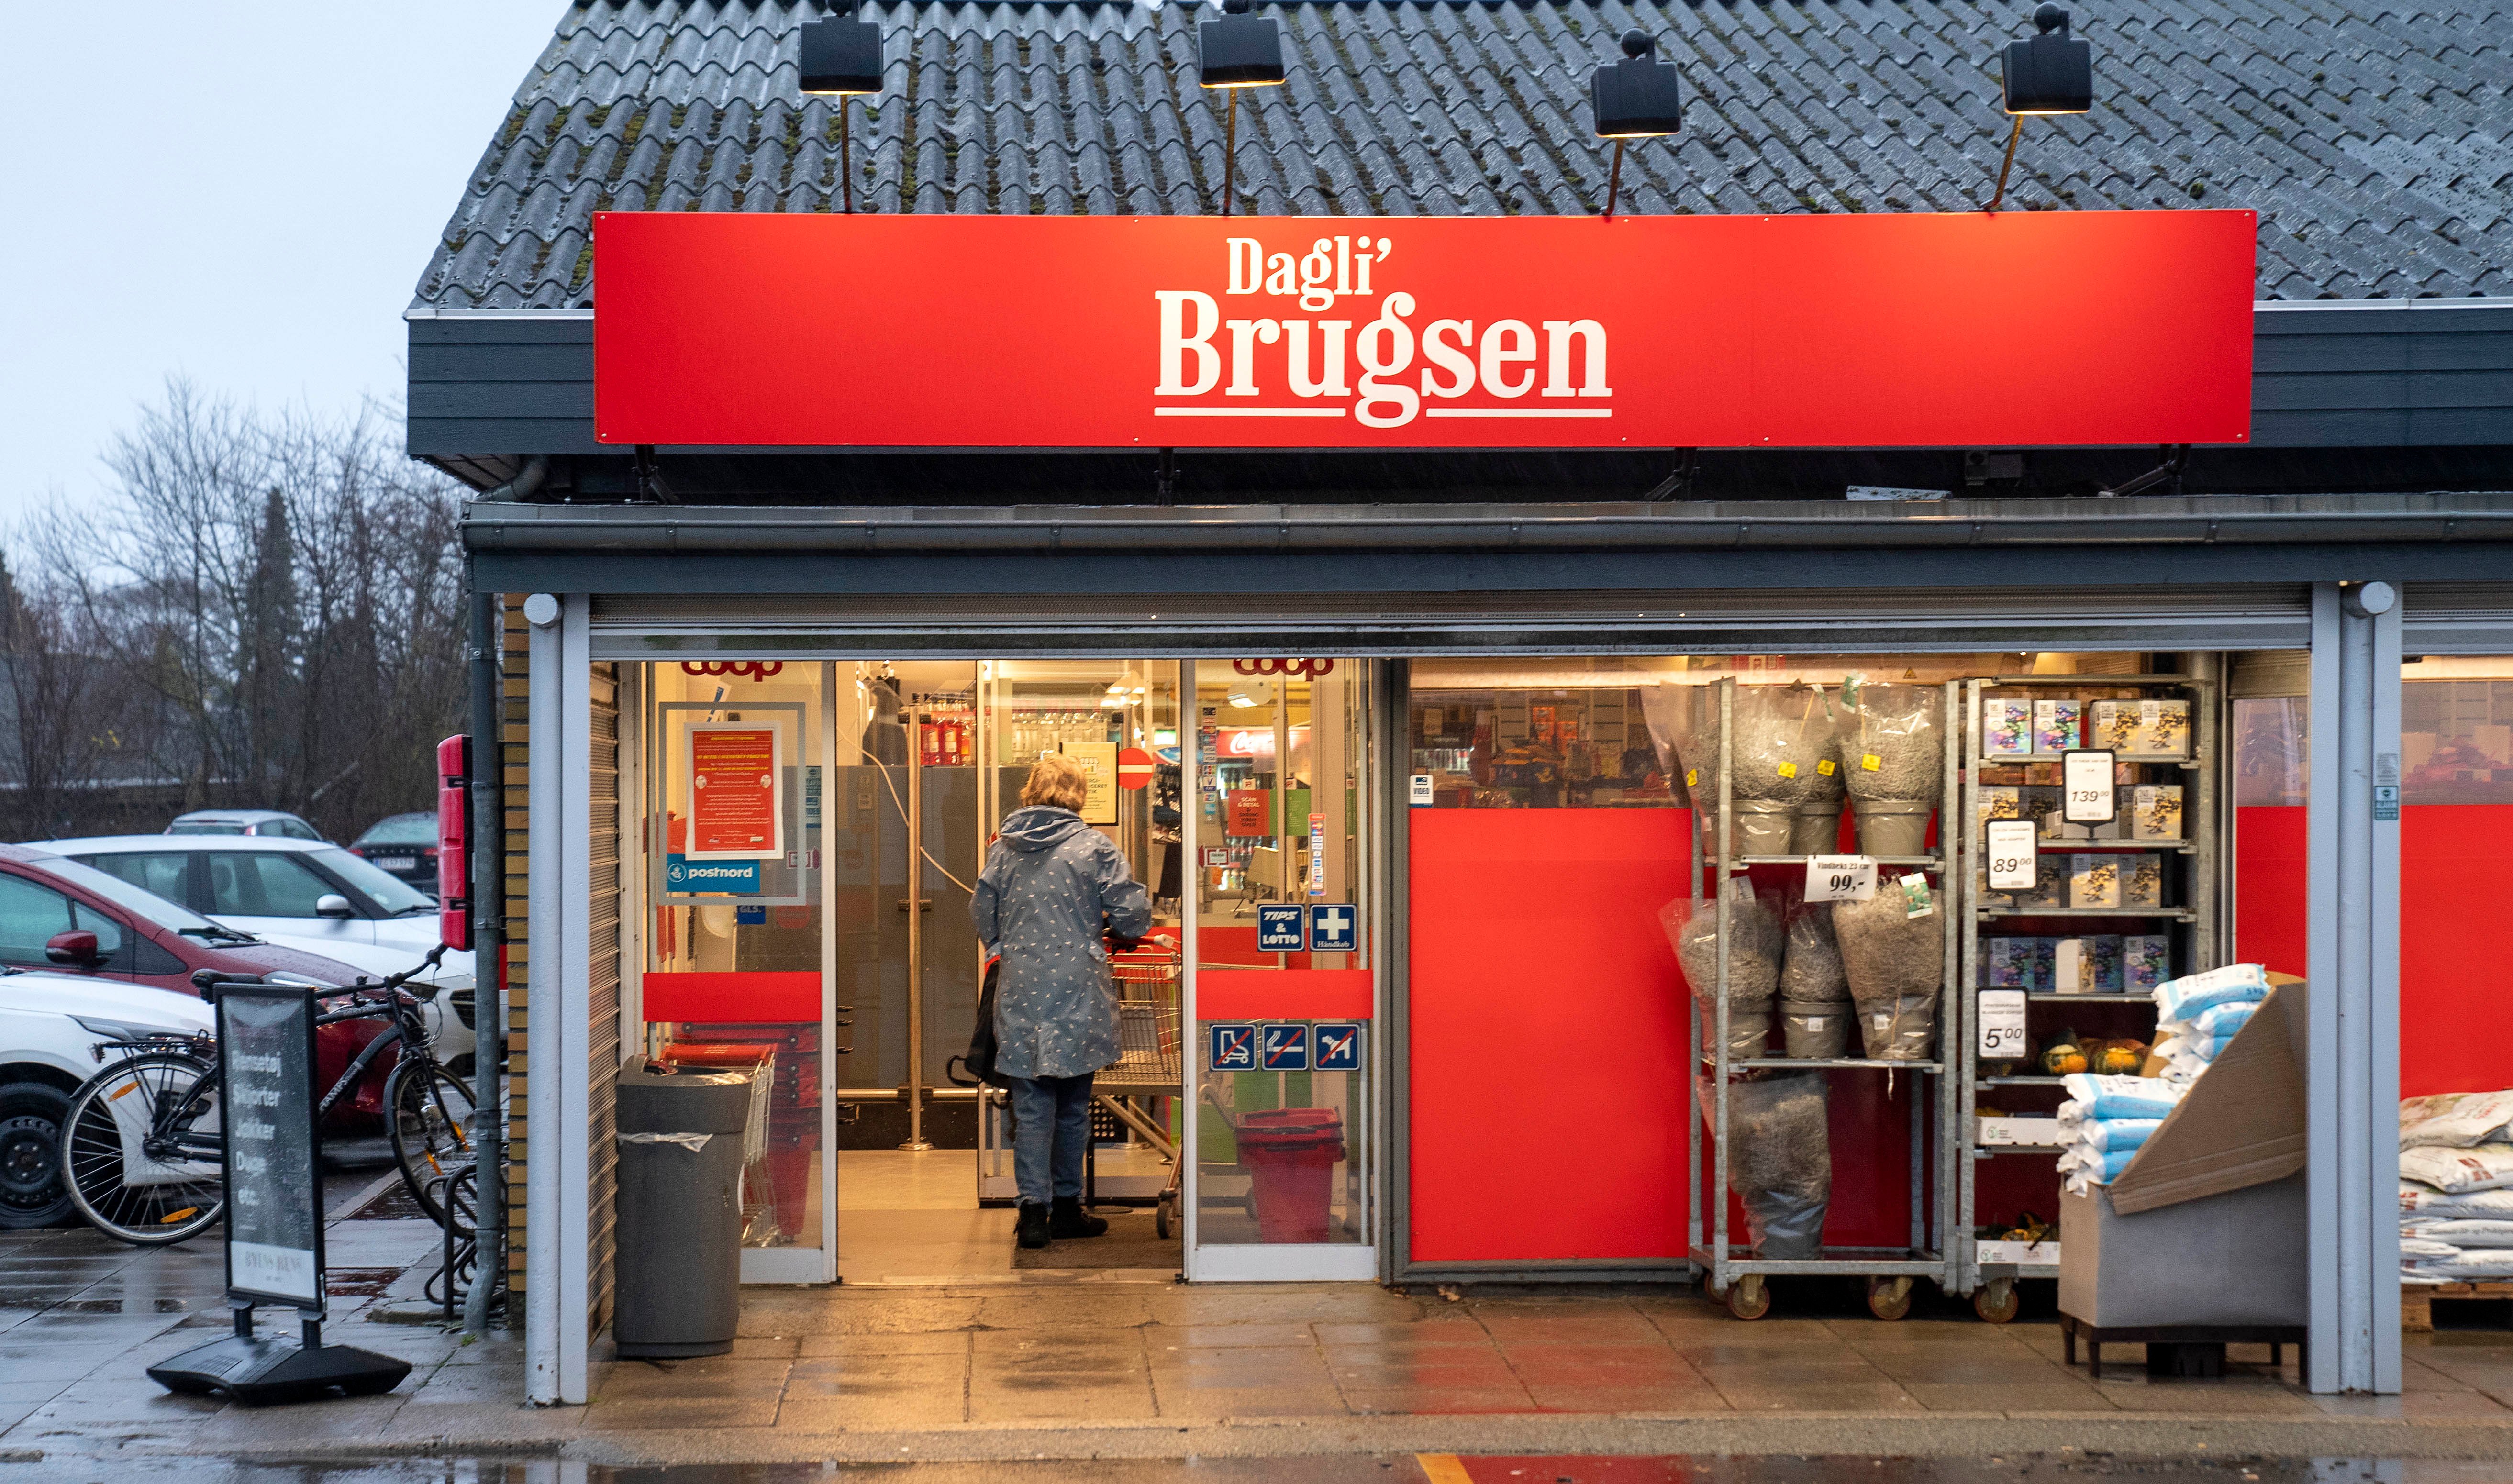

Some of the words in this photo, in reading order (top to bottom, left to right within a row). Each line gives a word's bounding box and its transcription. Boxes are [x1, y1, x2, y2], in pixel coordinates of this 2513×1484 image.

[1154, 290, 1613, 428] Brugsen
[688, 867, 753, 879] postnord
[1829, 875, 1865, 892] 99,-
[1263, 911, 1299, 921] TIPS
[1275, 922, 1287, 933] &
[1262, 934, 1300, 945] LOTTO
